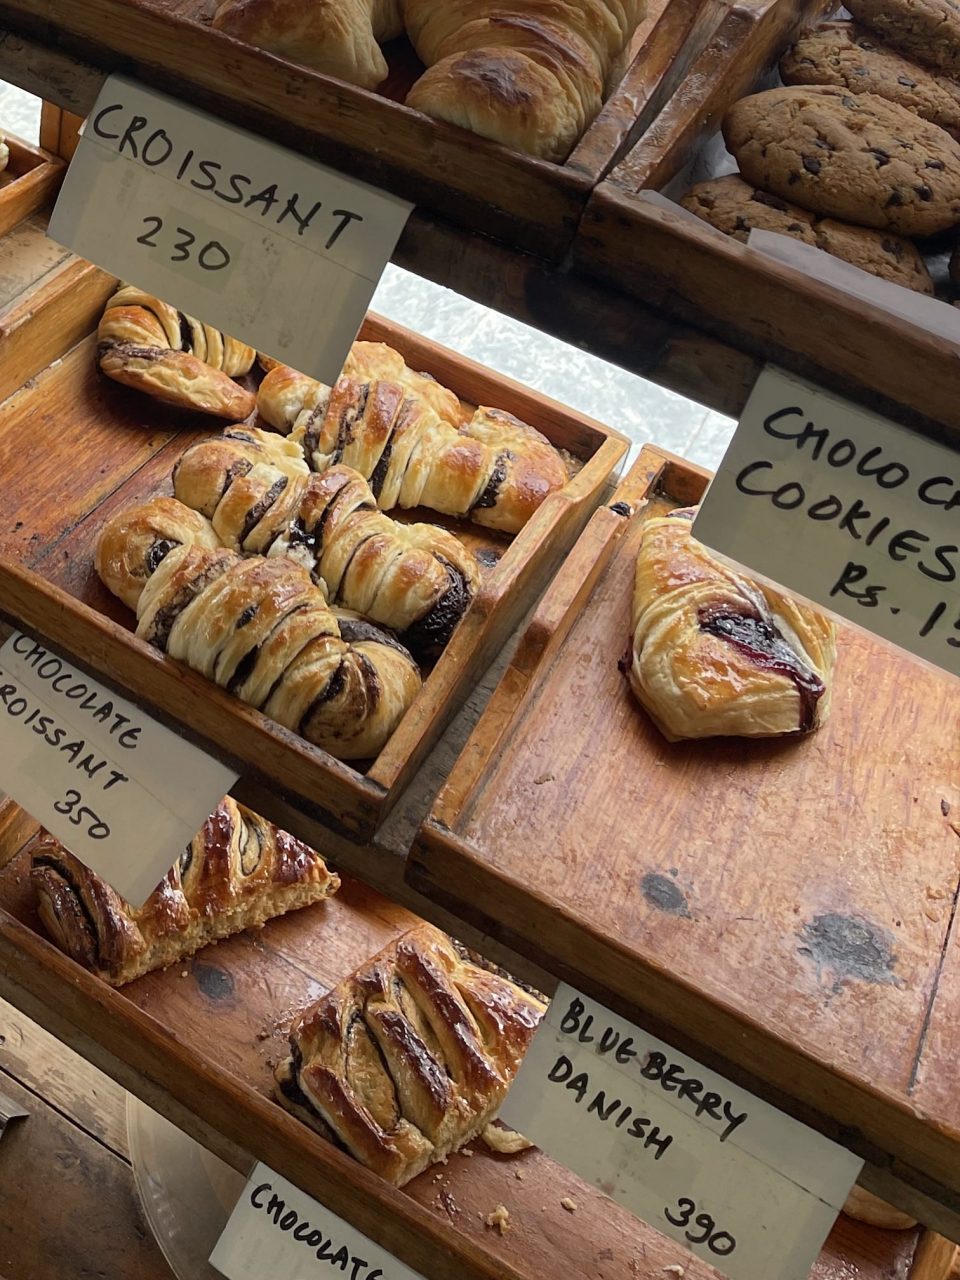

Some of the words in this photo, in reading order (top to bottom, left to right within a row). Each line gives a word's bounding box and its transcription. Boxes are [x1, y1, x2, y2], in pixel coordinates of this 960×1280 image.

[92, 104, 363, 250] CROISSANT
[136, 216, 231, 271] 230
[735, 460, 959, 582] COOKIES
[12, 632, 142, 749] CHOCOLATE
[53, 789, 110, 840] 350
[547, 1055, 673, 1160] DANISH
[664, 1197, 736, 1256] 390
